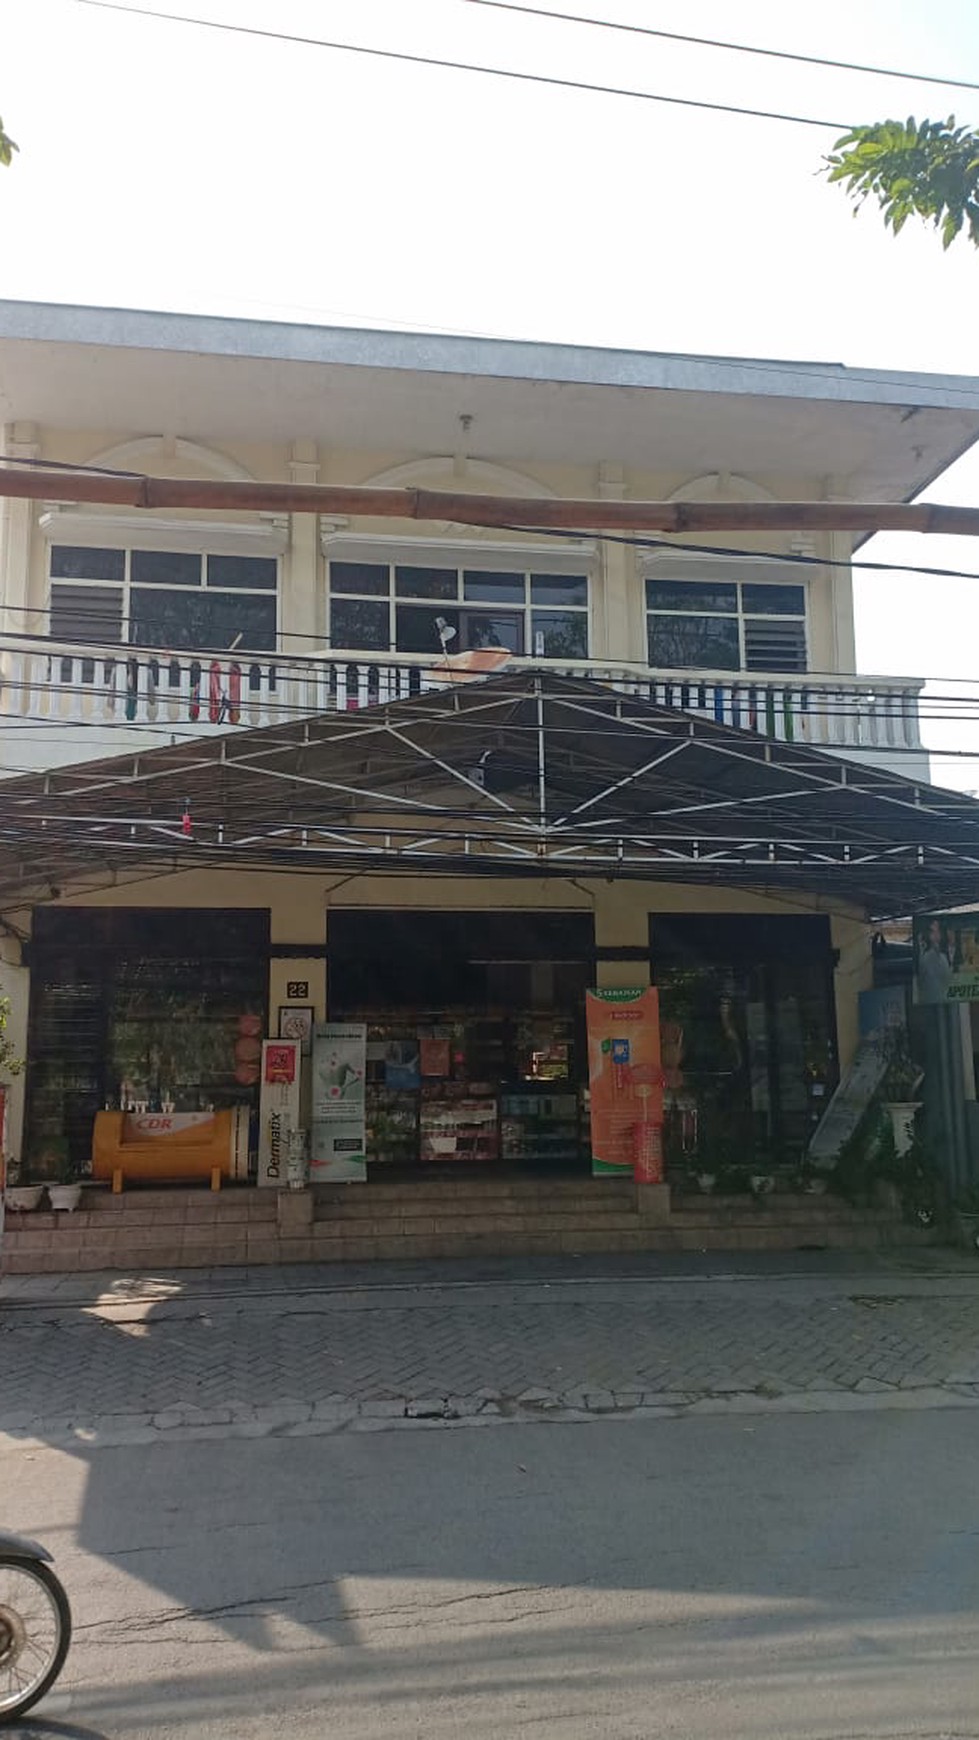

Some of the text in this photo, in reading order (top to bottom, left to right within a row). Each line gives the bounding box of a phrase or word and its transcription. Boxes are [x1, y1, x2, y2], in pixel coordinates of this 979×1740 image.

[289, 984, 306, 996] 22
[136, 1118, 173, 1130] CDR
[266, 1112, 282, 1179] Dermatix
